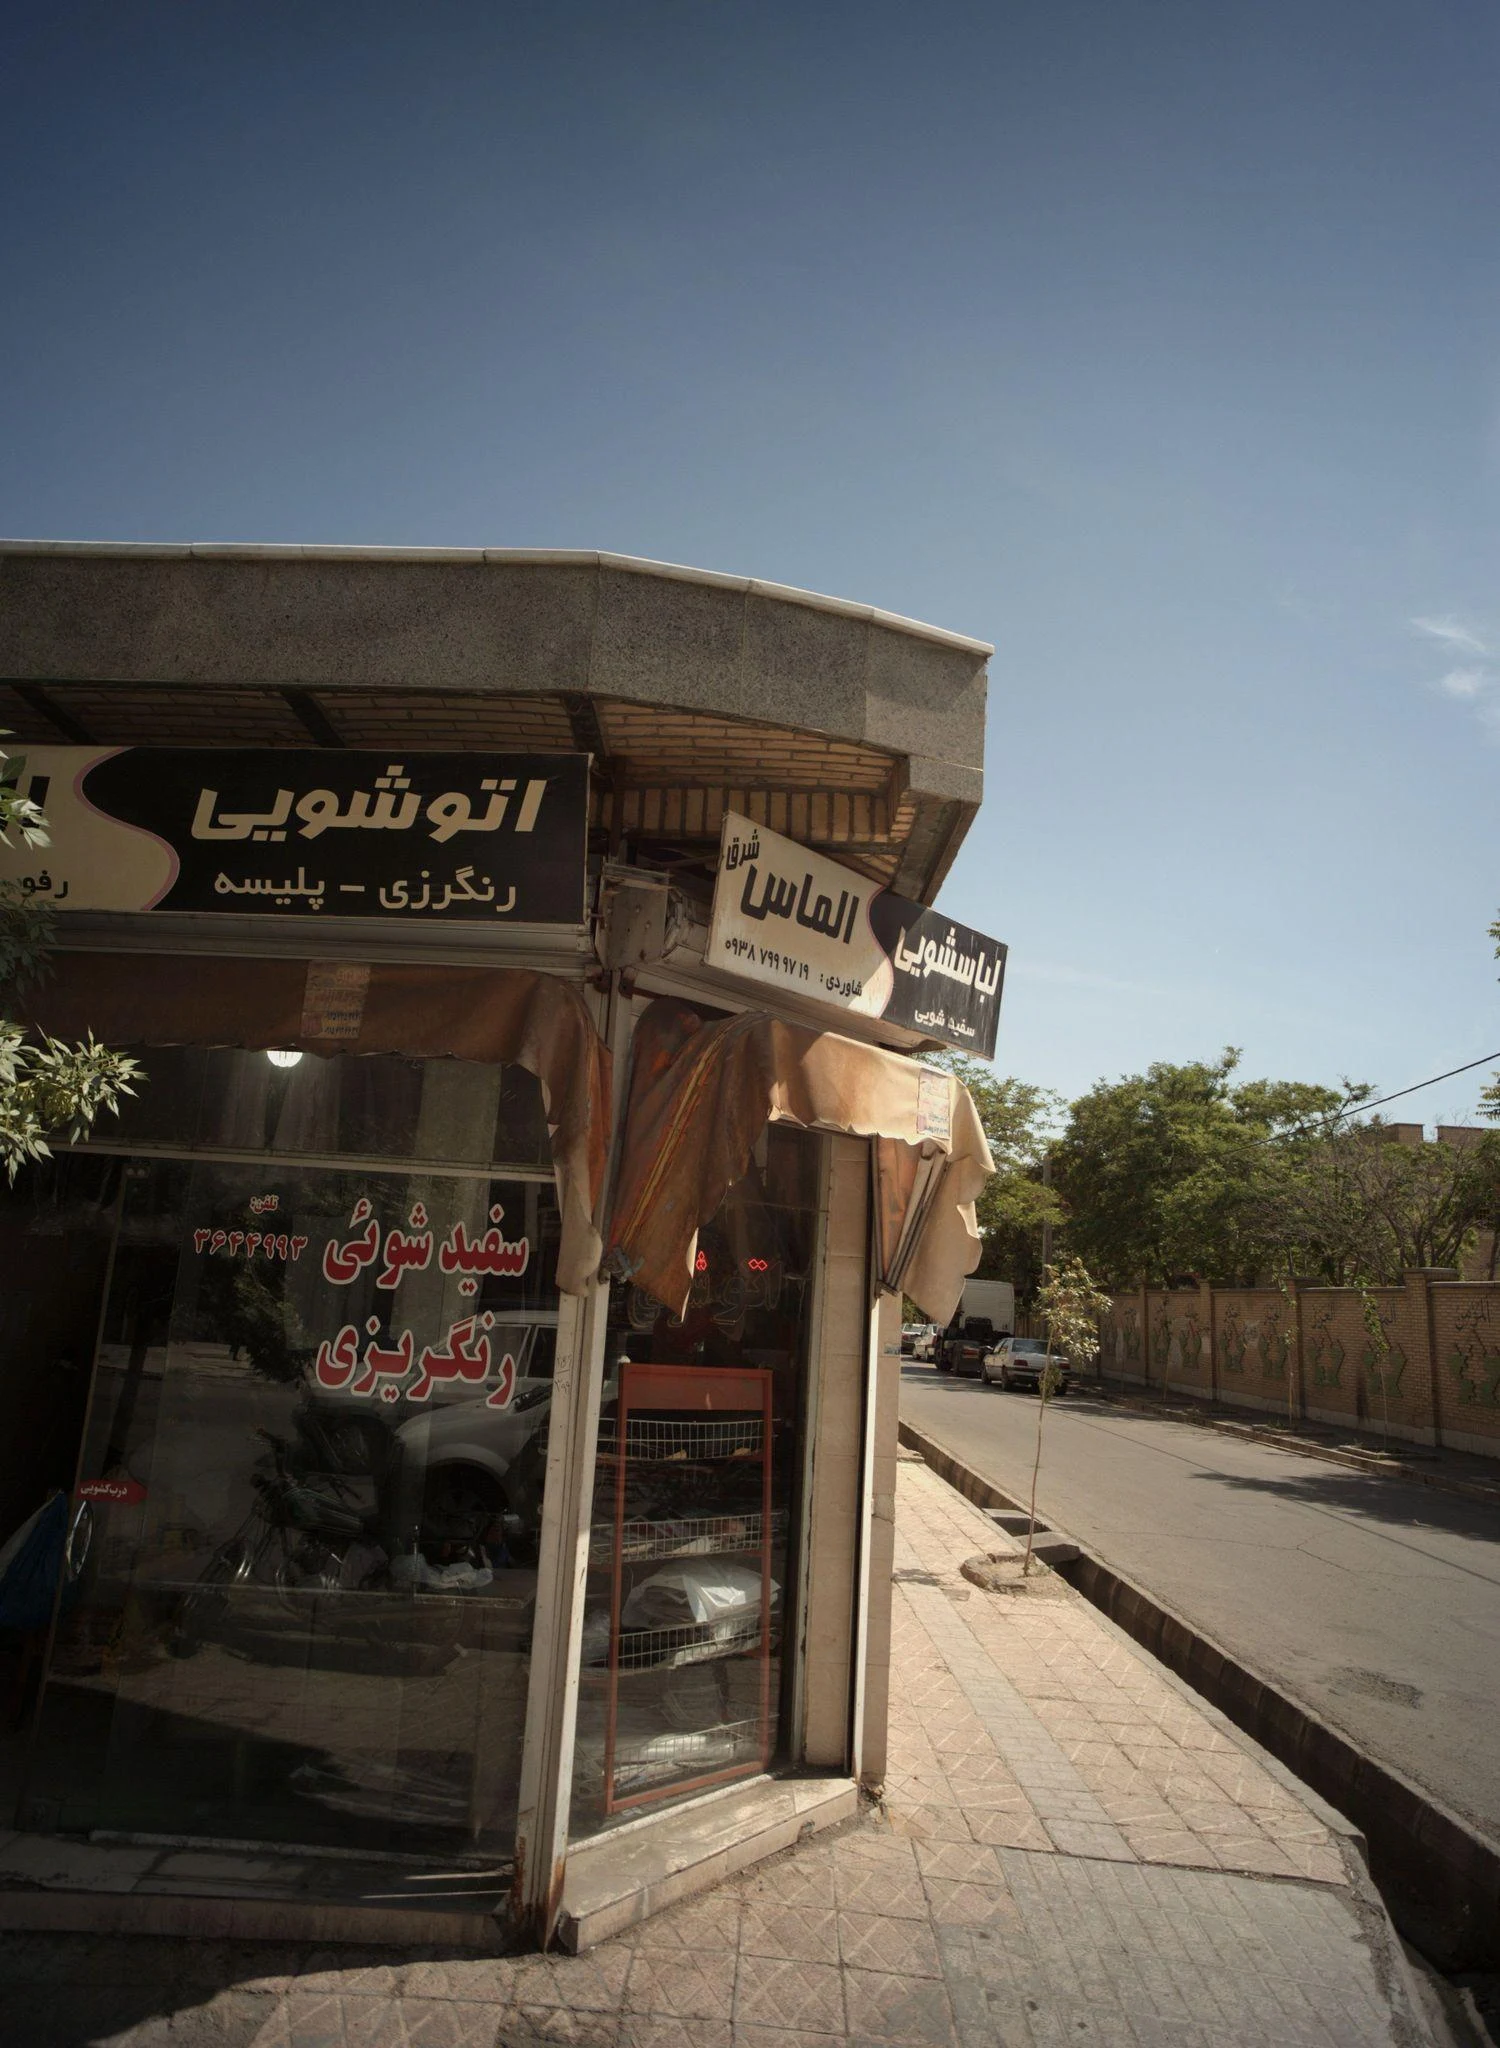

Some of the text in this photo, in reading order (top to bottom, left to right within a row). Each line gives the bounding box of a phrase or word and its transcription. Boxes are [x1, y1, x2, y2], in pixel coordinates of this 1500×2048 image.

[191, 765, 547, 842] اتوشویی
[726, 829, 760, 870] شرق
[214, 867, 325, 911] پلیسه
[379, 864, 516, 912] رنگرزی
[741, 864, 859, 944] الماس
[894, 925, 1002, 1003] لباسشویی
[914, 1008, 976, 1037] سفید شویی
[194, 1228, 308, 1261] ۳۶۴۴۹۹۳
[439, 1203, 529, 1296] سفید
[316, 1310, 516, 1409] رنگریزی
